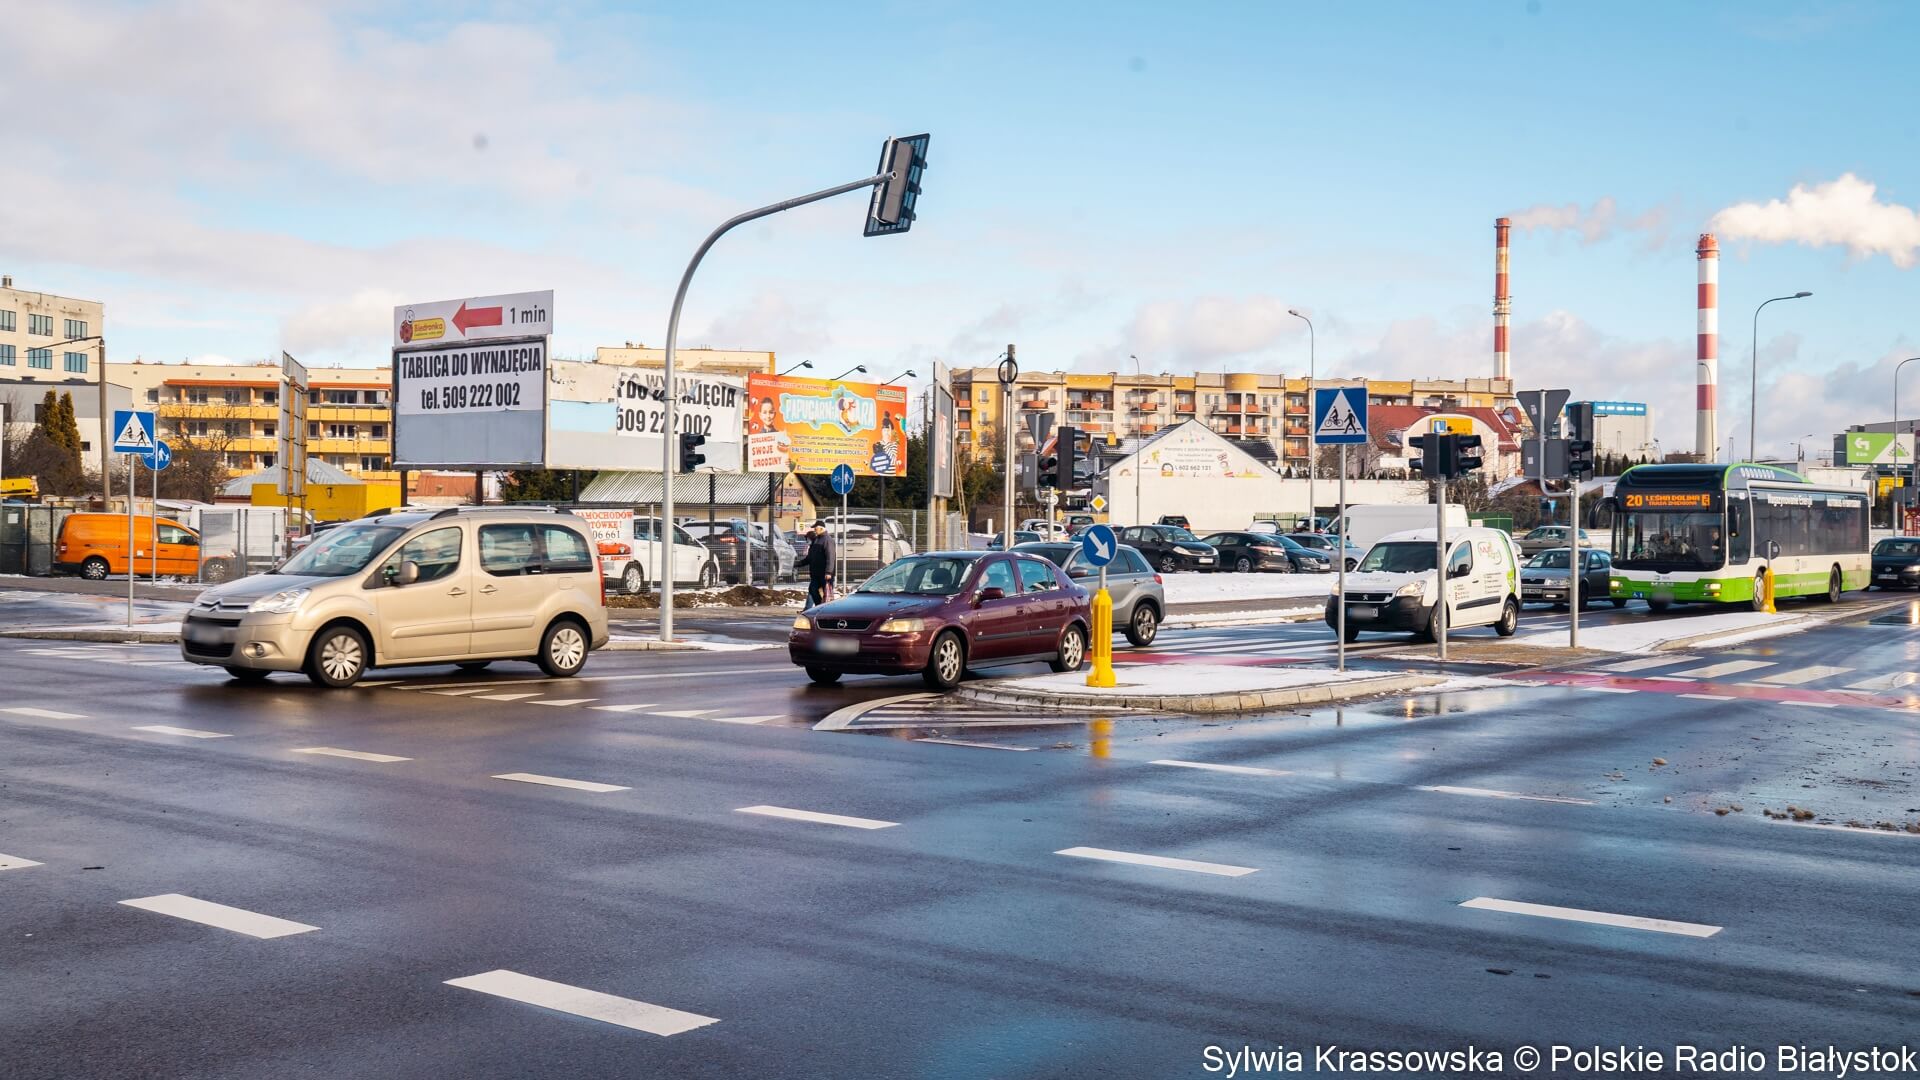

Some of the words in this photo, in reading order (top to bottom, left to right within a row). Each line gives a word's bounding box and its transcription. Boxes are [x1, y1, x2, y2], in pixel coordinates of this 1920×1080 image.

[510, 307, 515, 325] 1
[521, 304, 546, 324] min
[402, 354, 449, 379] TABLICA
[451, 353, 468, 377] DO
[471, 347, 541, 376] WYNAJĘCIA
[421, 387, 440, 410] tel.
[443, 385, 467, 409] 509
[470, 383, 493, 408] 222
[496, 382, 520, 407] 002
[683, 413, 712, 437] 002
[1626, 494, 1642, 507] 20
[606, 530, 621, 539] 661
